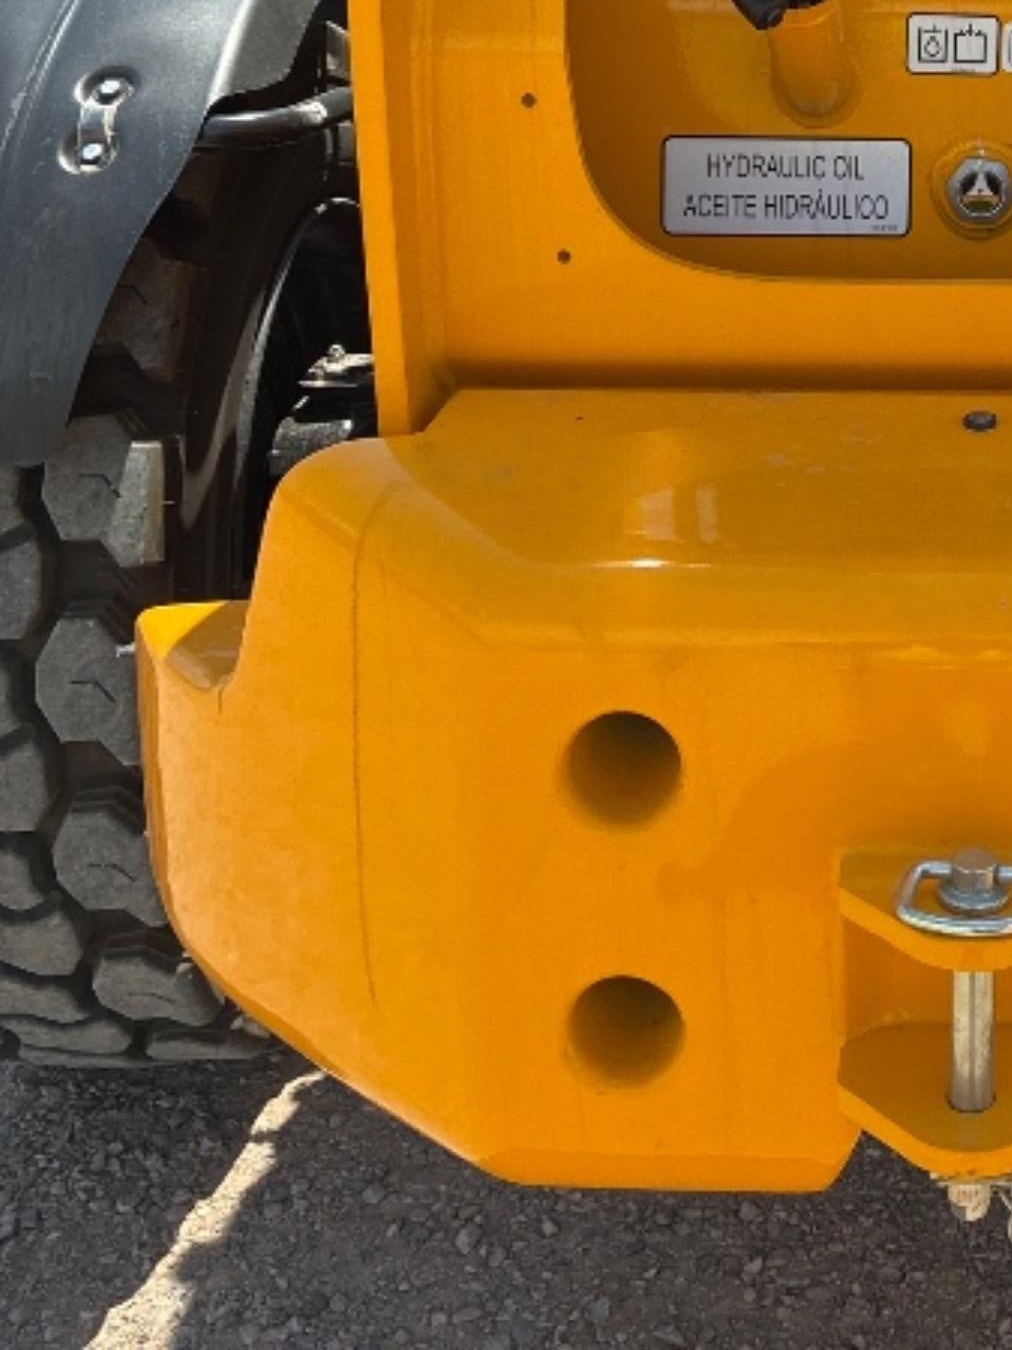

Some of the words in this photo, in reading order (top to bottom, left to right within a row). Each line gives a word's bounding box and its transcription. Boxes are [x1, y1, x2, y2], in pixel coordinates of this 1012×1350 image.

[706, 154, 826, 179] HYDRAULIC
[833, 156, 865, 180] OIL
[682, 193, 757, 219] ACEITE
[763, 189, 889, 220] HIDRÁULICO
